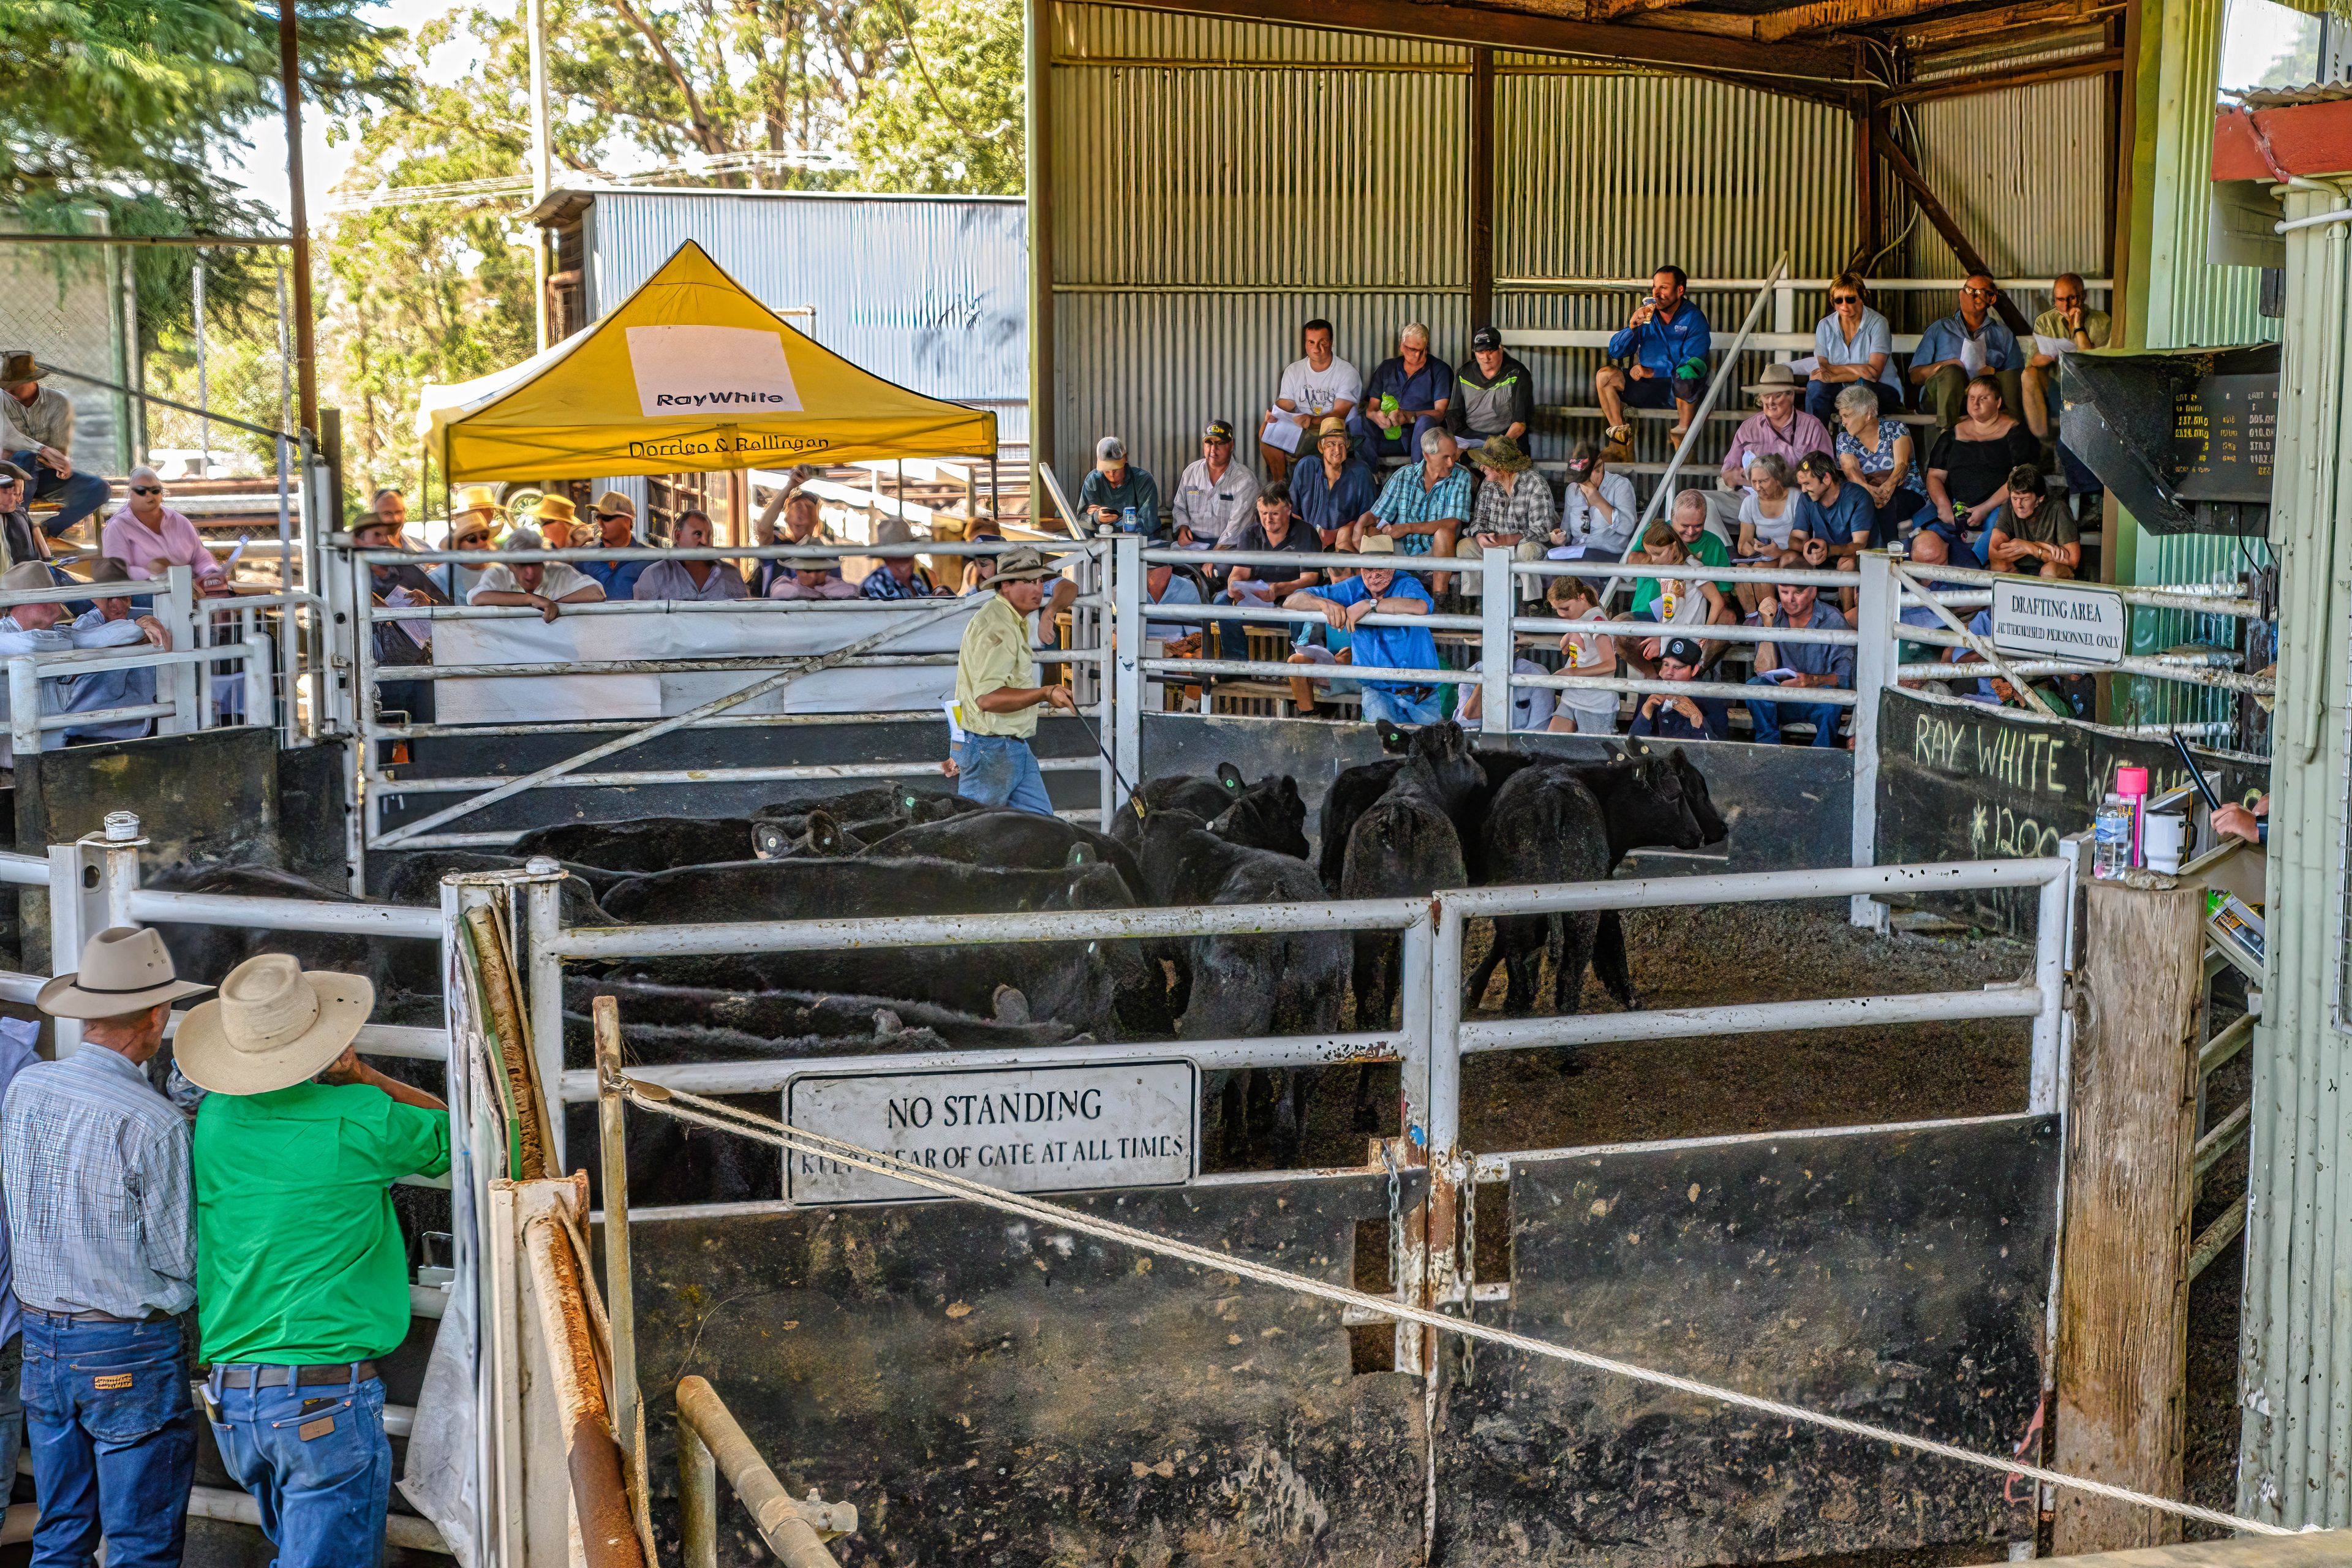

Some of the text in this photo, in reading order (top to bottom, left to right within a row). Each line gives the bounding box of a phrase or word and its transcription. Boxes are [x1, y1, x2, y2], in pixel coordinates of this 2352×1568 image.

[2012, 595, 2101, 623] DRAFTING AREA
[2096, 633, 2121, 649] ONLY
[1915, 714, 1965, 770] RAY
[1977, 725, 2067, 793] WHITE
[888, 1088, 1101, 1129] NO STANDING
[865, 1148, 936, 1171] EAR
[943, 1145, 971, 1169] OF
[978, 1142, 1035, 1167] GATE
[1041, 1140, 1068, 1164] AT
[1073, 1138, 1114, 1162] ALL
[1117, 1134, 1184, 1159] TIMES
